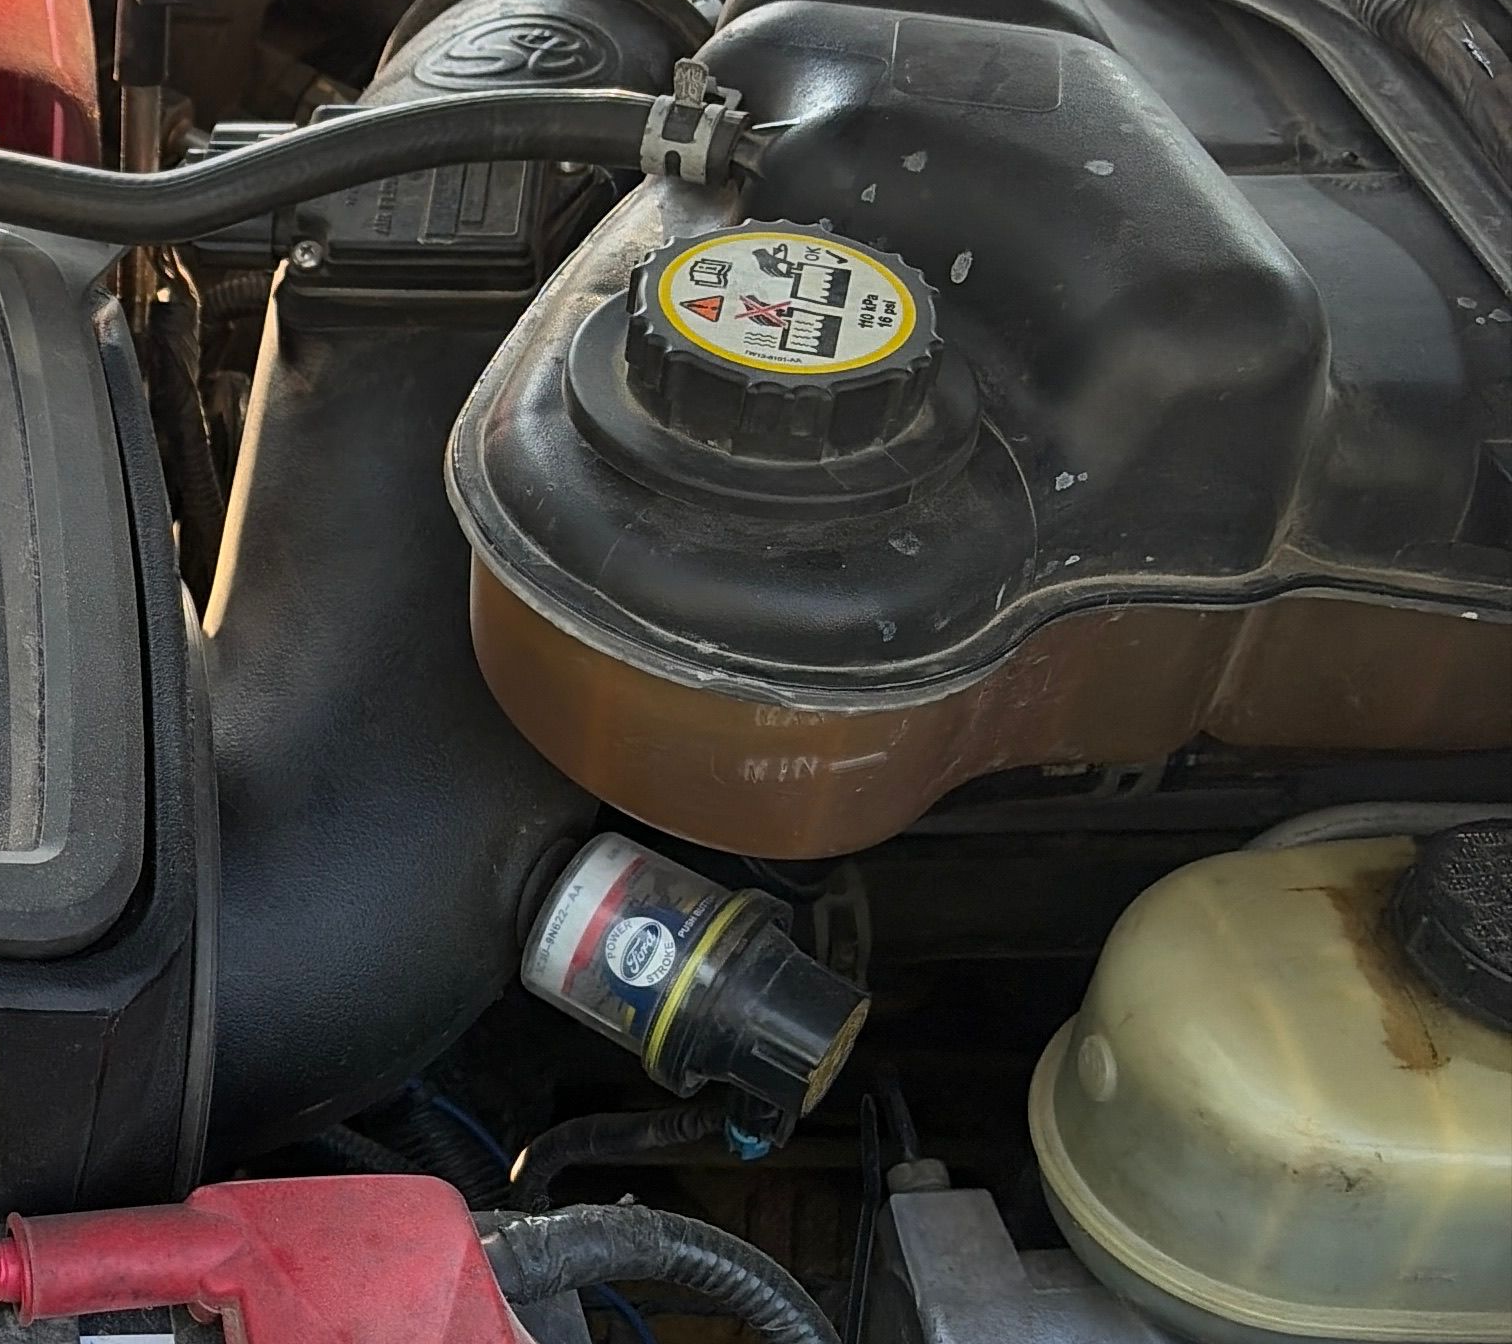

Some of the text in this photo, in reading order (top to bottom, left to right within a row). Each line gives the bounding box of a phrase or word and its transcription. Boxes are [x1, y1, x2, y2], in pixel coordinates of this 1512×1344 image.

[804, 245, 822, 262] OK
[858, 293, 879, 329] 110 kPa
[877, 299, 897, 329] 16 psi
[744, 756, 819, 784] MIN
[606, 920, 634, 960] POWER
[677, 915, 697, 938] PUSH
[625, 924, 662, 976] Ford
[645, 940, 676, 985] STROKE
